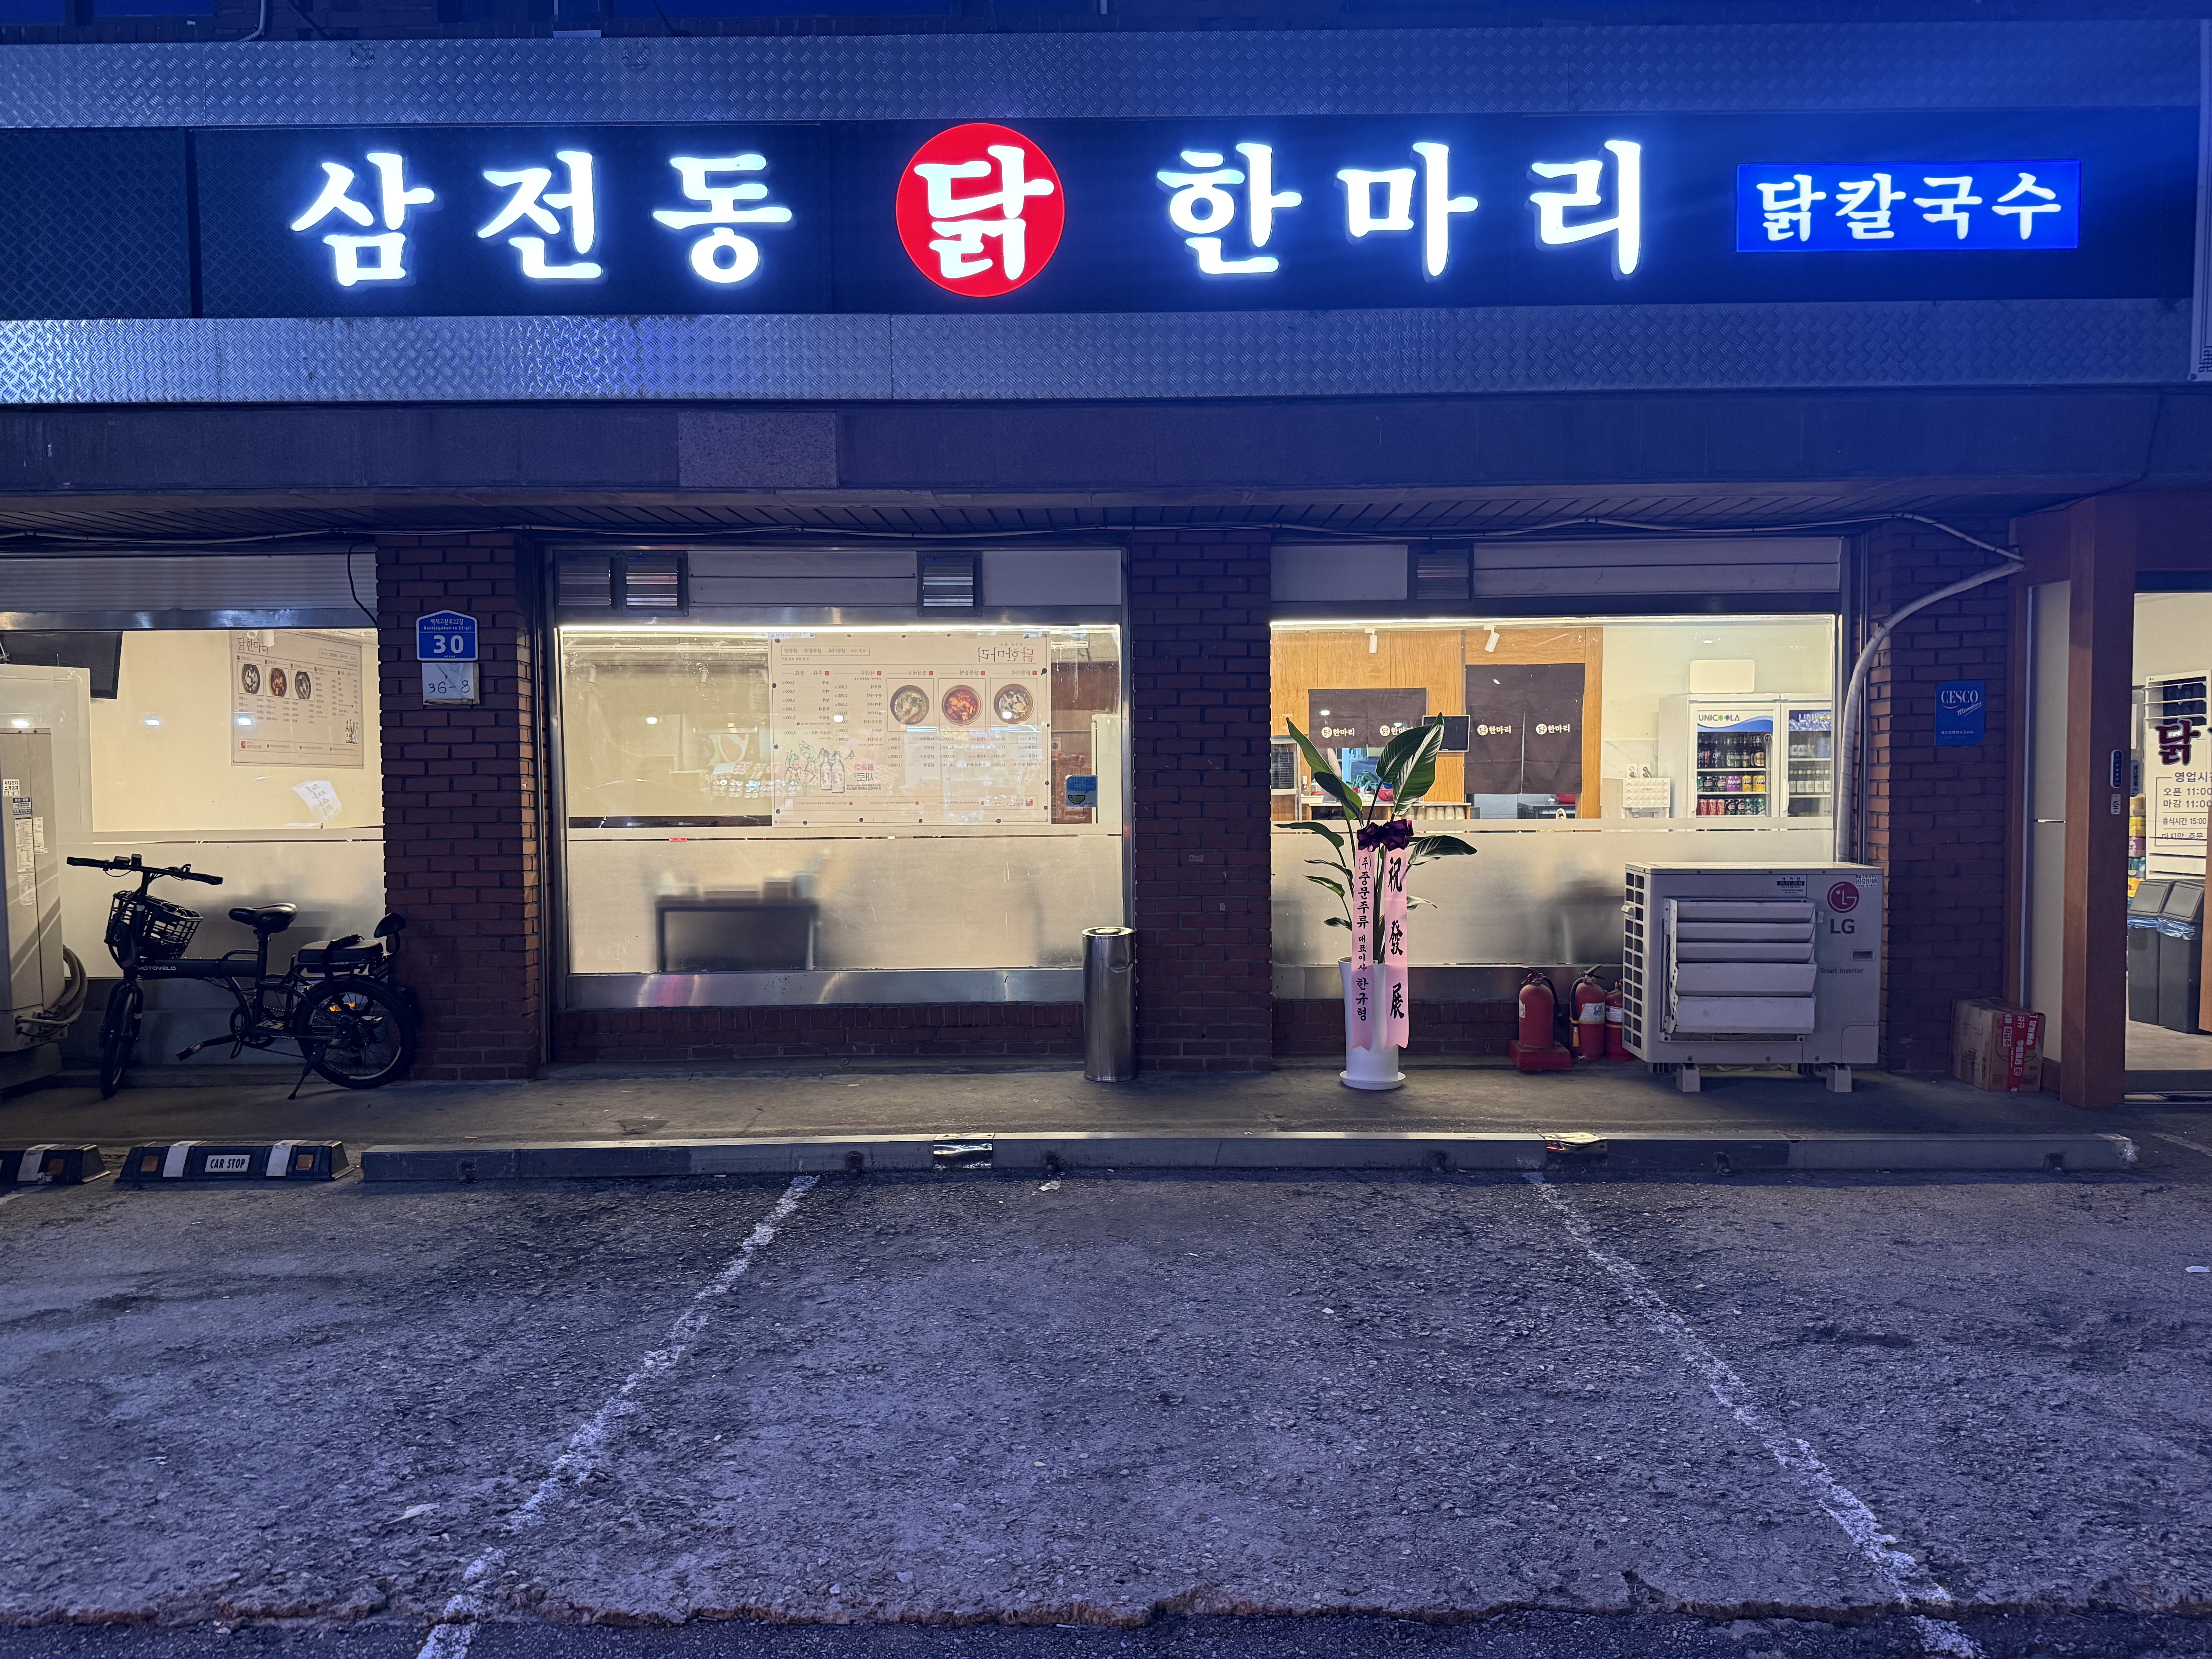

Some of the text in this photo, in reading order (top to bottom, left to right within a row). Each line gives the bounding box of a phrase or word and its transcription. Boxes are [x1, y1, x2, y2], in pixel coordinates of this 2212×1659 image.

[291, 139, 1642, 287] 삼전동 닭 한마리
[1756, 172, 2061, 241] 닭칼국수
[433, 635, 464, 654] 30
[428, 680, 470, 694] 36-8
[1941, 690, 1978, 704] CESCO
[2155, 718, 2202, 766] 닭
[2163, 787, 2212, 797] 오픈 11:00
[2163, 799, 2182, 808] 마감
[2162, 817, 2188, 825] 휴식시간
[1830, 918, 1855, 934] LG
[1357, 934, 1367, 972] 대표이사
[1355, 977, 1369, 1022] 한규형
[210, 1158, 246, 1169] CAR STOP
